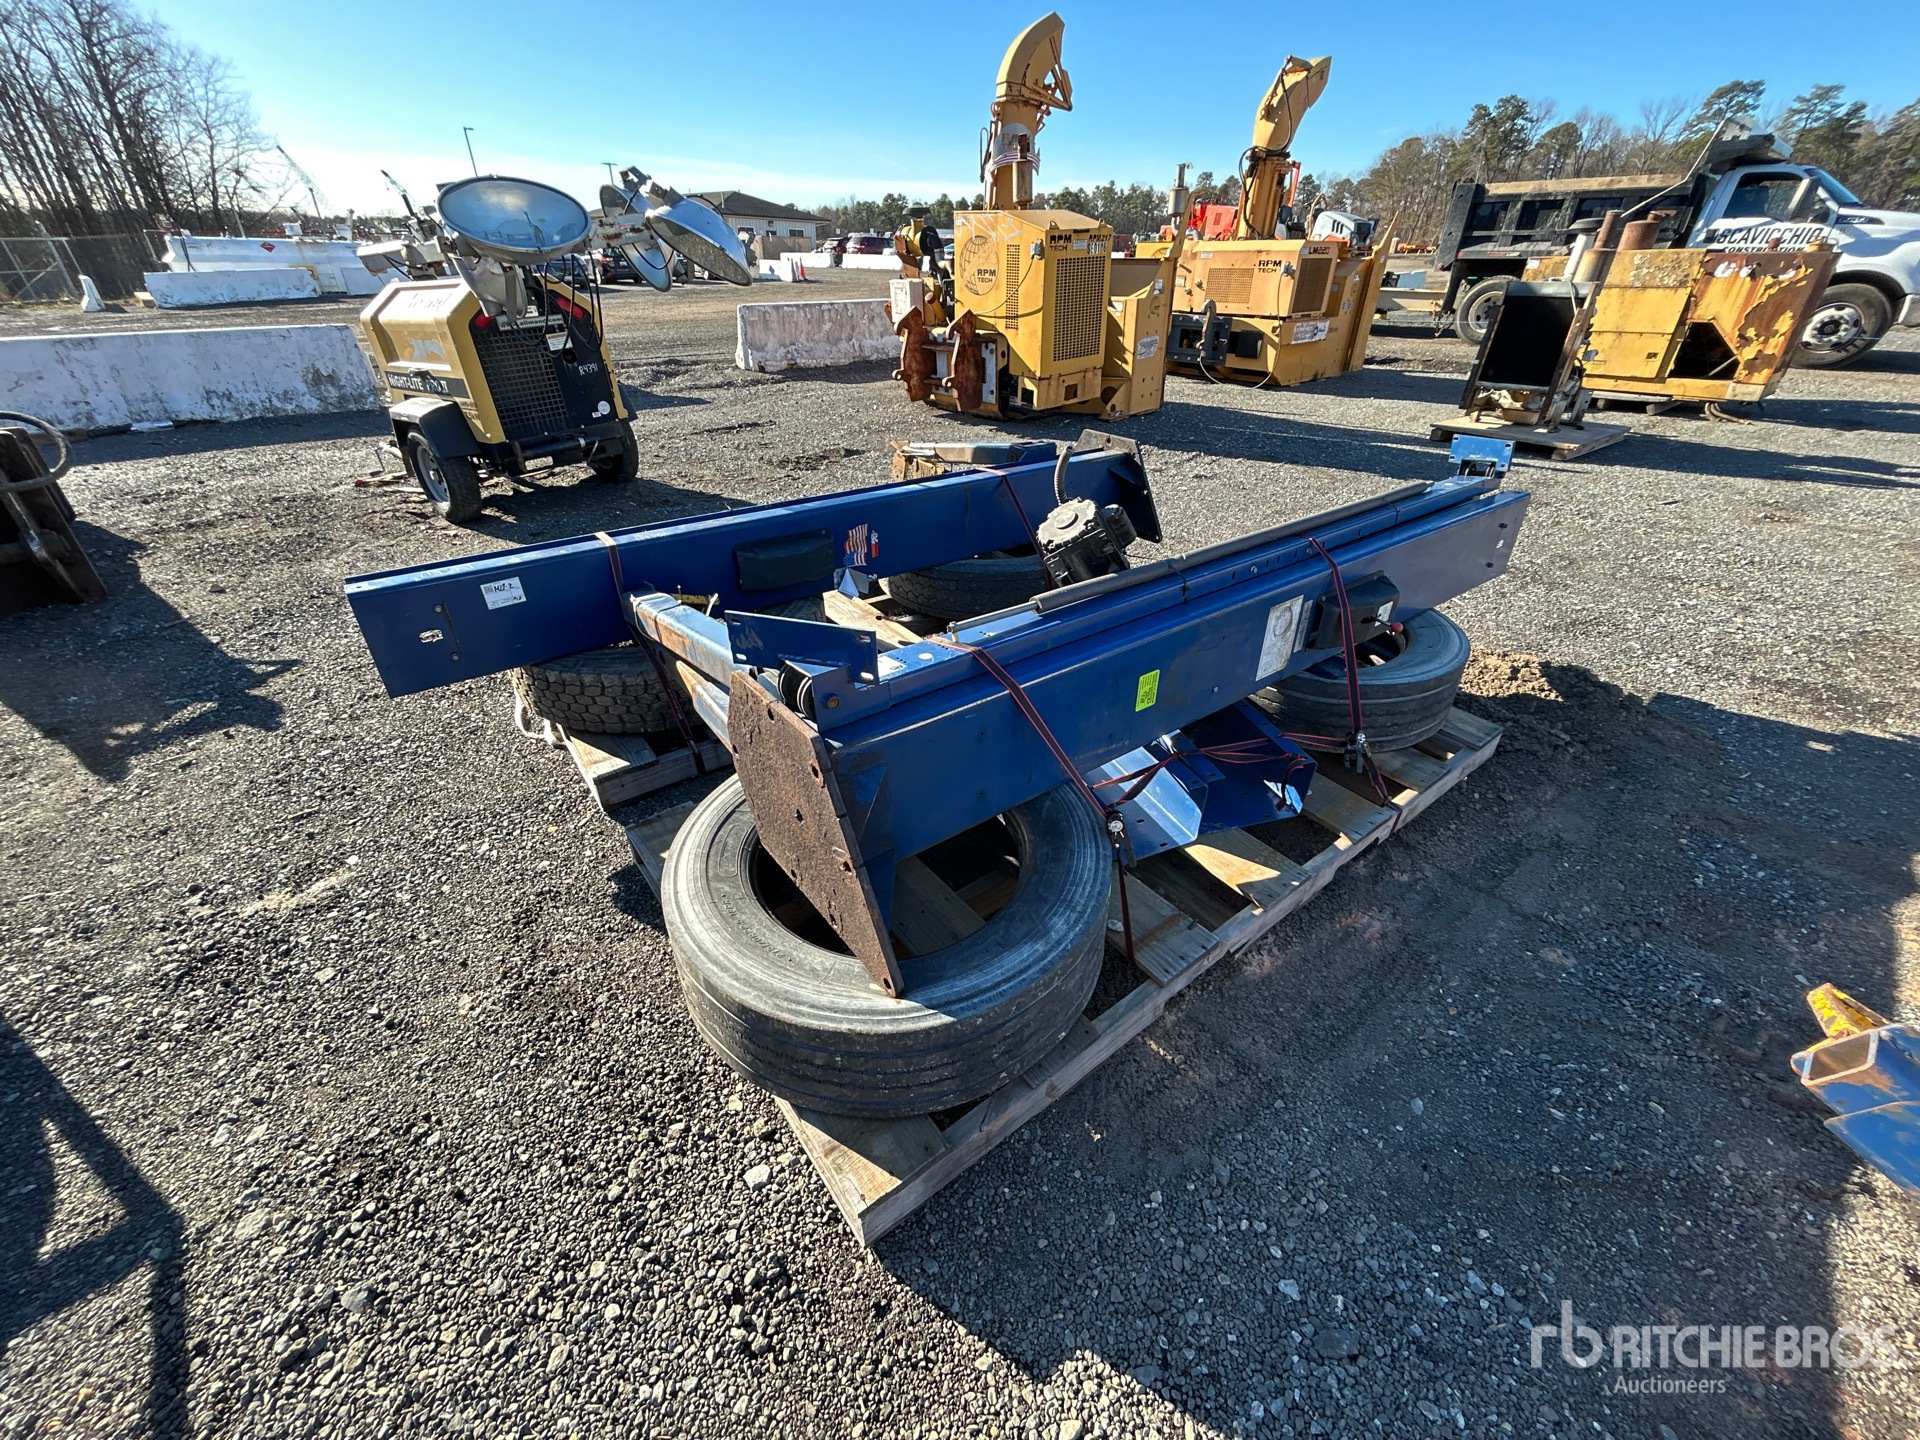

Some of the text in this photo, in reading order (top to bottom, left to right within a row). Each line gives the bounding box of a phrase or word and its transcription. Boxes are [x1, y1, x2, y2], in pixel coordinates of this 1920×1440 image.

[1049, 234, 1072, 244] RPM
[1258, 259, 1282, 267] RPM
[977, 268, 997, 277] RPM
[500, 317, 563, 328] wwwallmandcom
[578, 363, 598, 375] R4391
